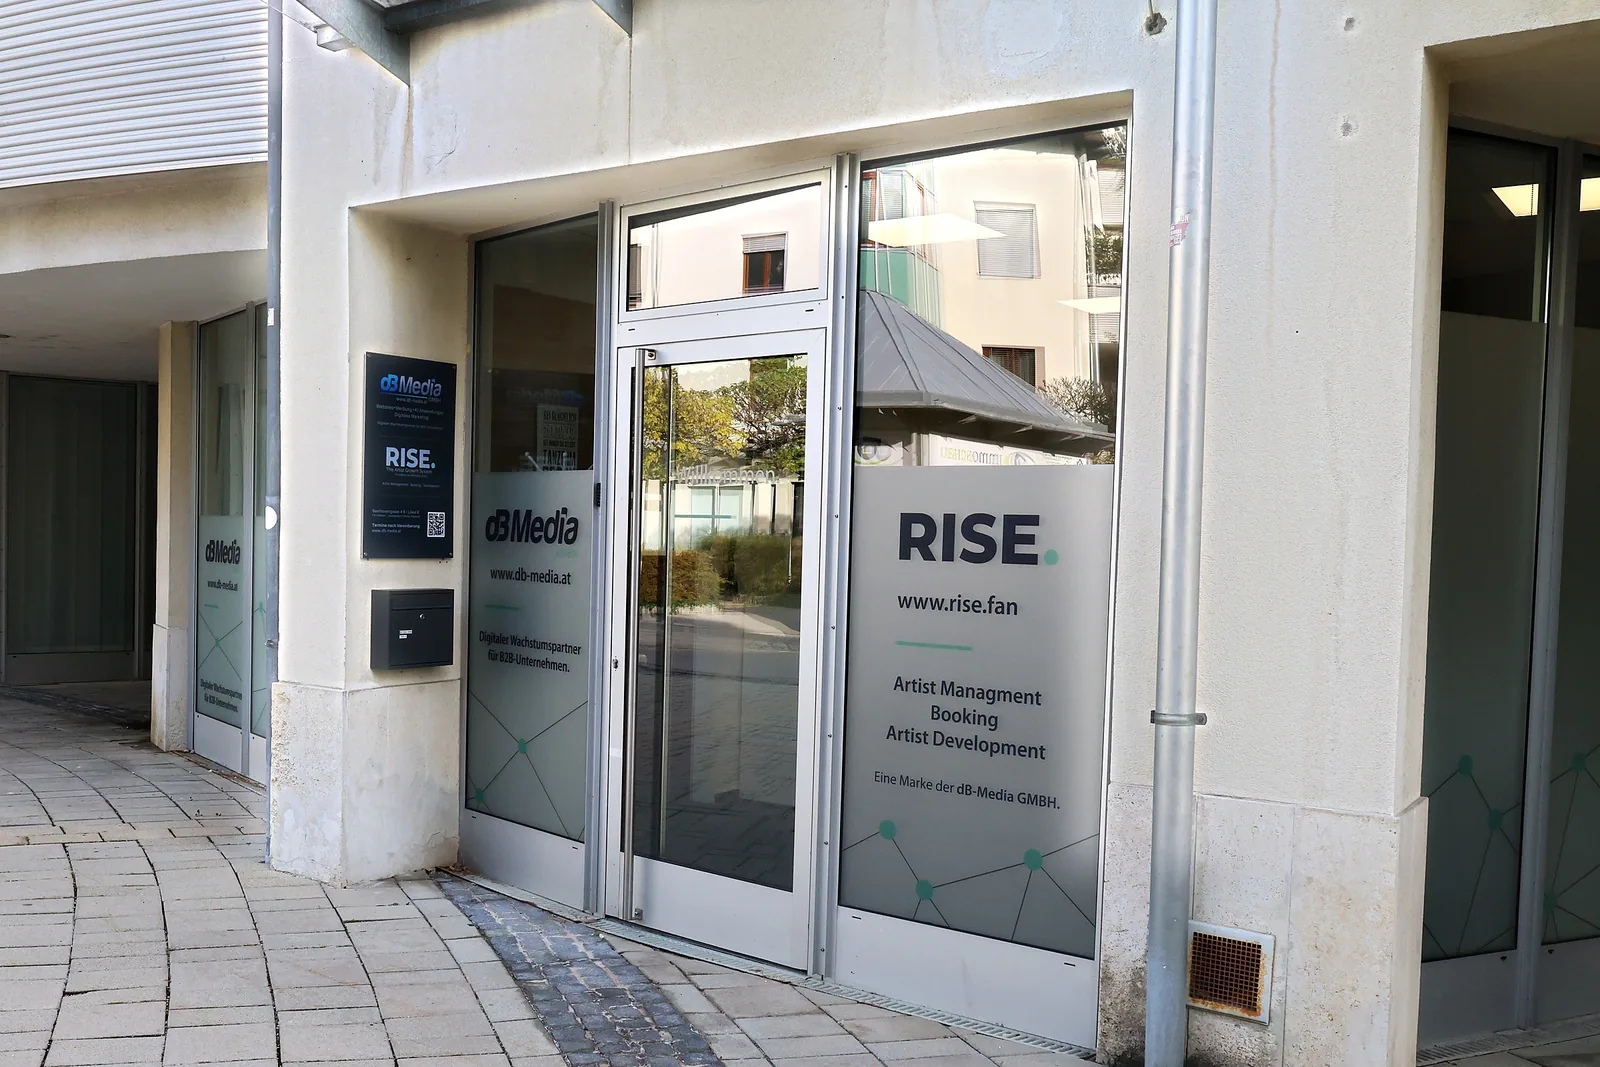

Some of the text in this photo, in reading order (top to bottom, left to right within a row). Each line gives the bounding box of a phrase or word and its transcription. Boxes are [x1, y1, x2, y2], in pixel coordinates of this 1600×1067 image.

[385, 446, 436, 469] RISE.
[898, 512, 1059, 566] RISE.
[490, 566, 571, 585] www.db-media.at
[897, 594, 1018, 616] www.rise.fan
[479, 630, 582, 655] Digitaler Wachstumspartner
[488, 649, 570, 673] für B2B-Unternehmen.
[893, 675, 1042, 706] Artist Managment
[930, 705, 999, 731] Booking
[886, 725, 1047, 760] Artist Development
[874, 771, 1060, 810] Eine Marke der dB-Media GMBH.
